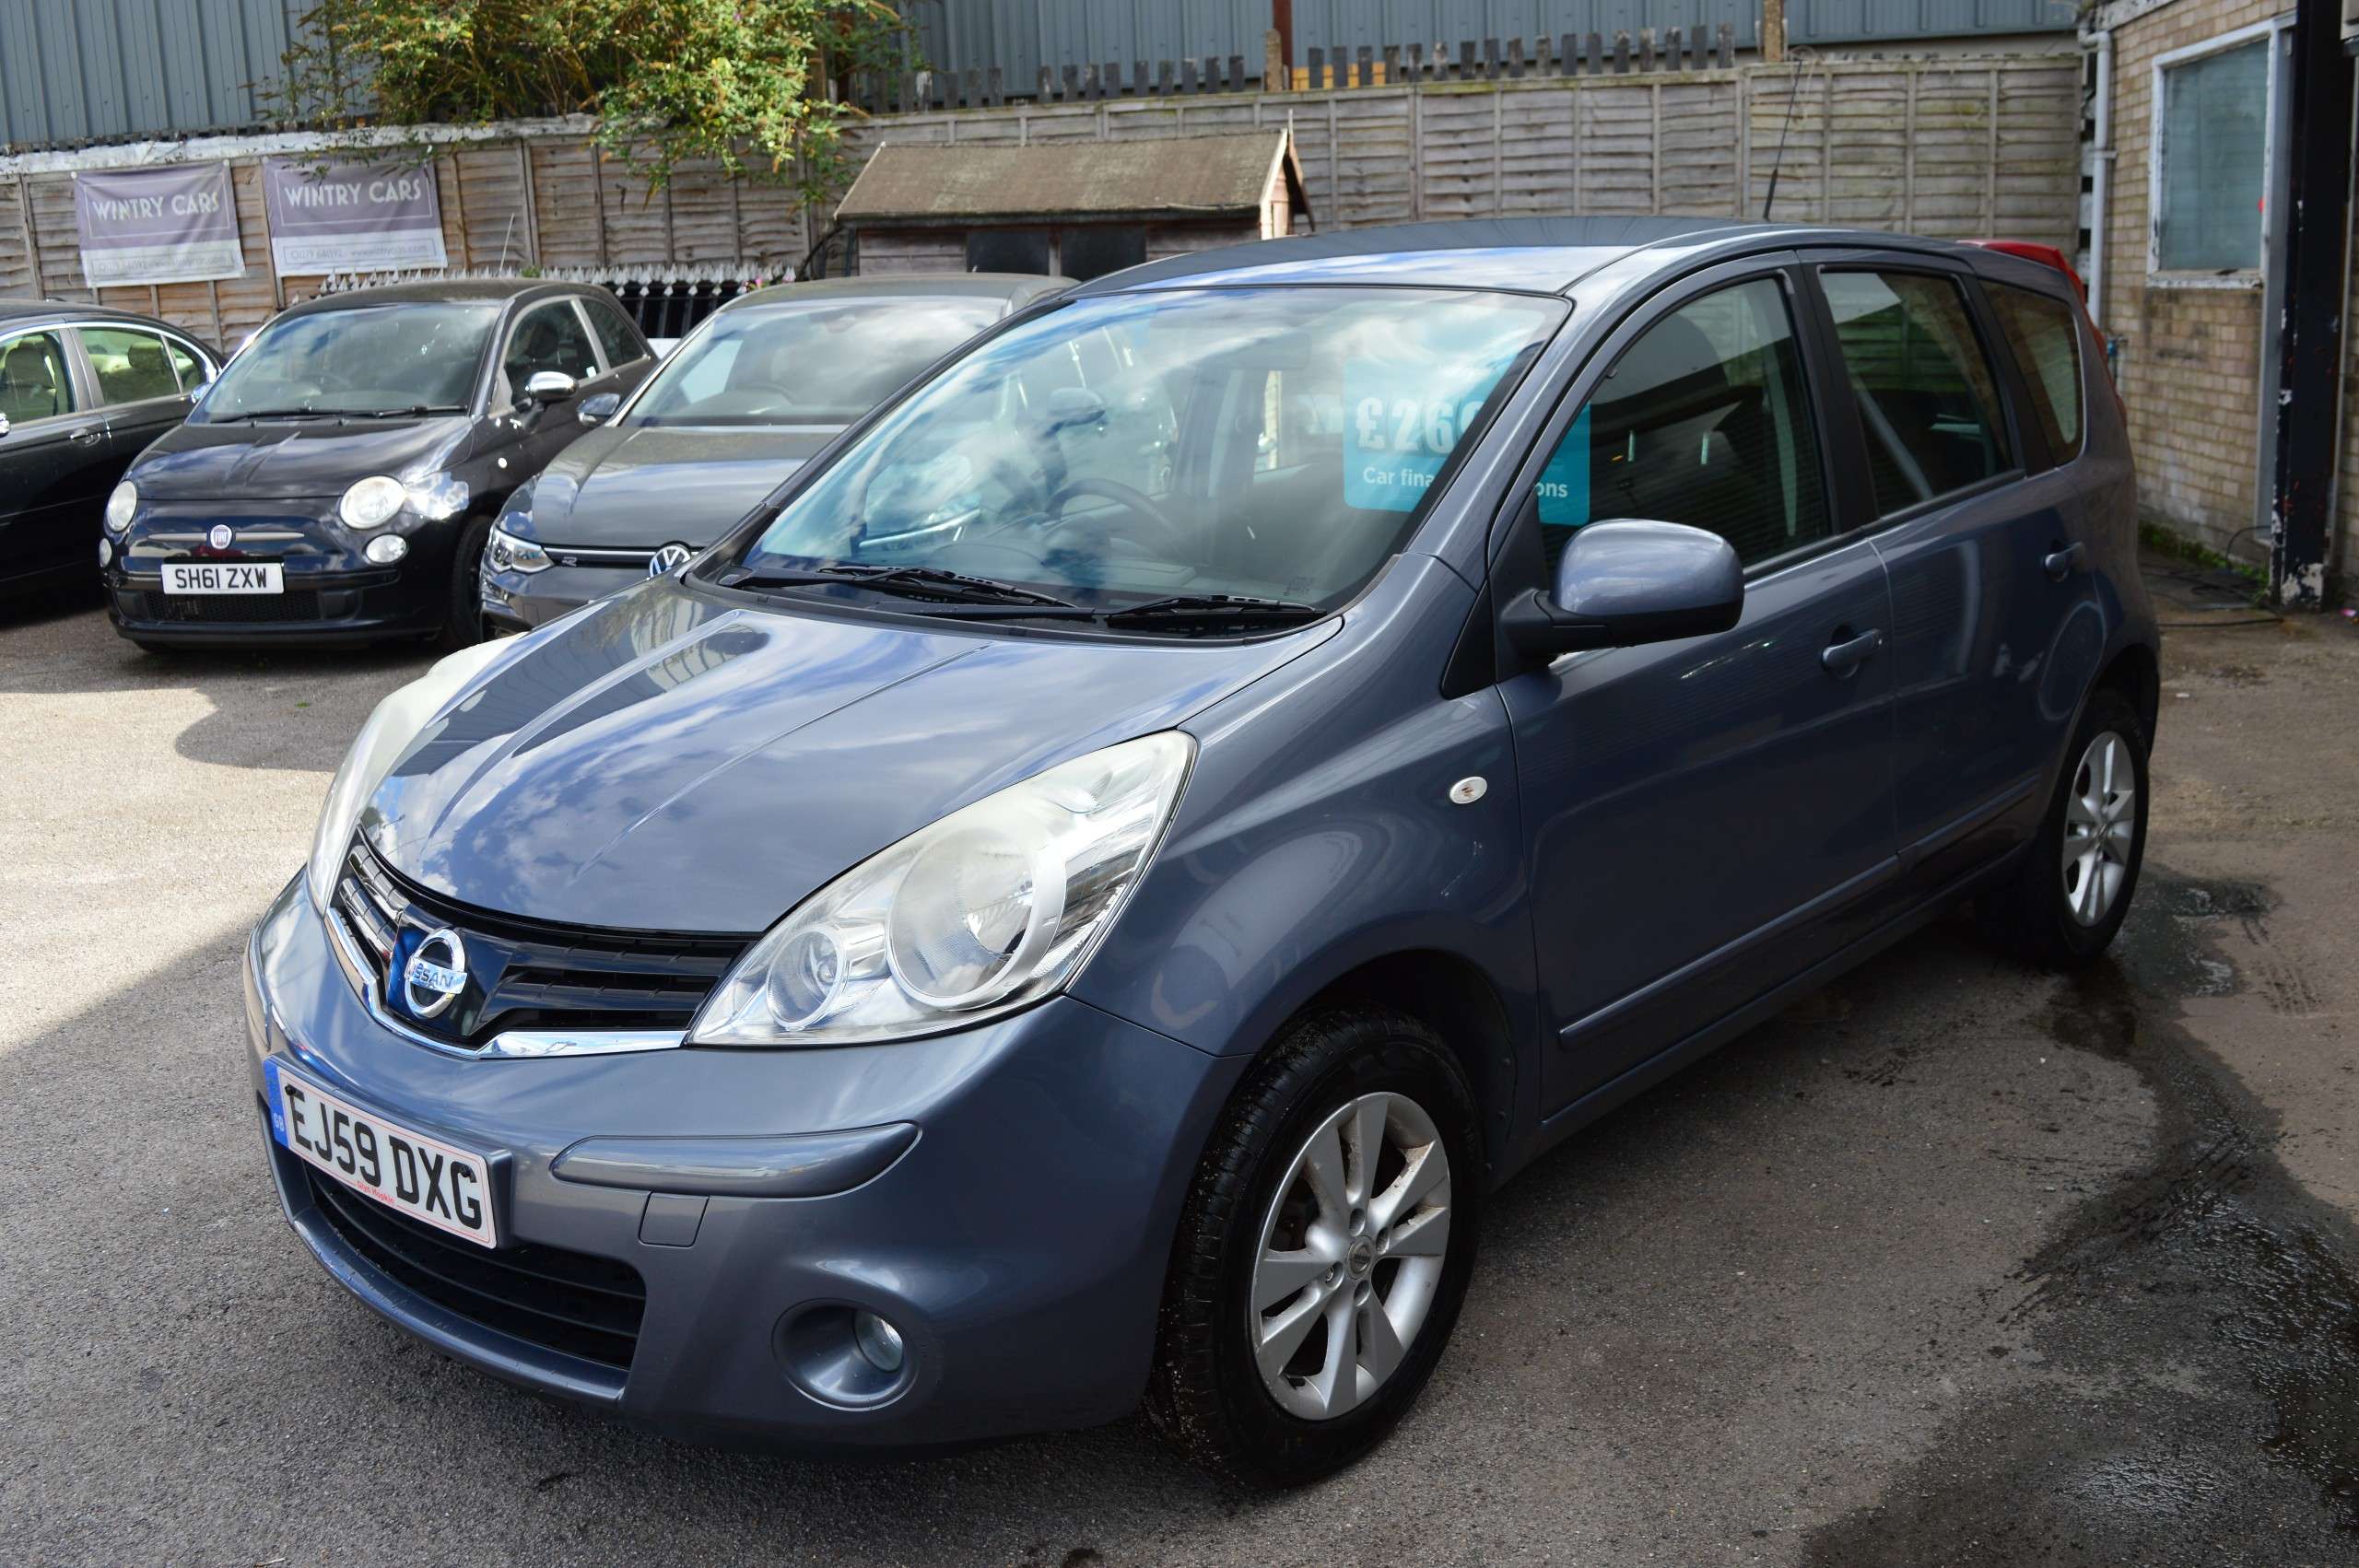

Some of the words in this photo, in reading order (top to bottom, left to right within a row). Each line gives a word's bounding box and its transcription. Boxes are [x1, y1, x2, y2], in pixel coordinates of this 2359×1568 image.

[92, 195, 164, 221] WINTRY
[170, 191, 220, 216] CARS
[283, 182, 362, 208] WINTRY
[369, 179, 422, 203] CARS
[1363, 466, 1395, 486] Car
[1401, 467, 1435, 486] fina
[175, 568, 221, 589] SH61
[226, 568, 267, 589] ZXW
[286, 1083, 381, 1187] EJ59
[388, 1134, 483, 1230] DXG
